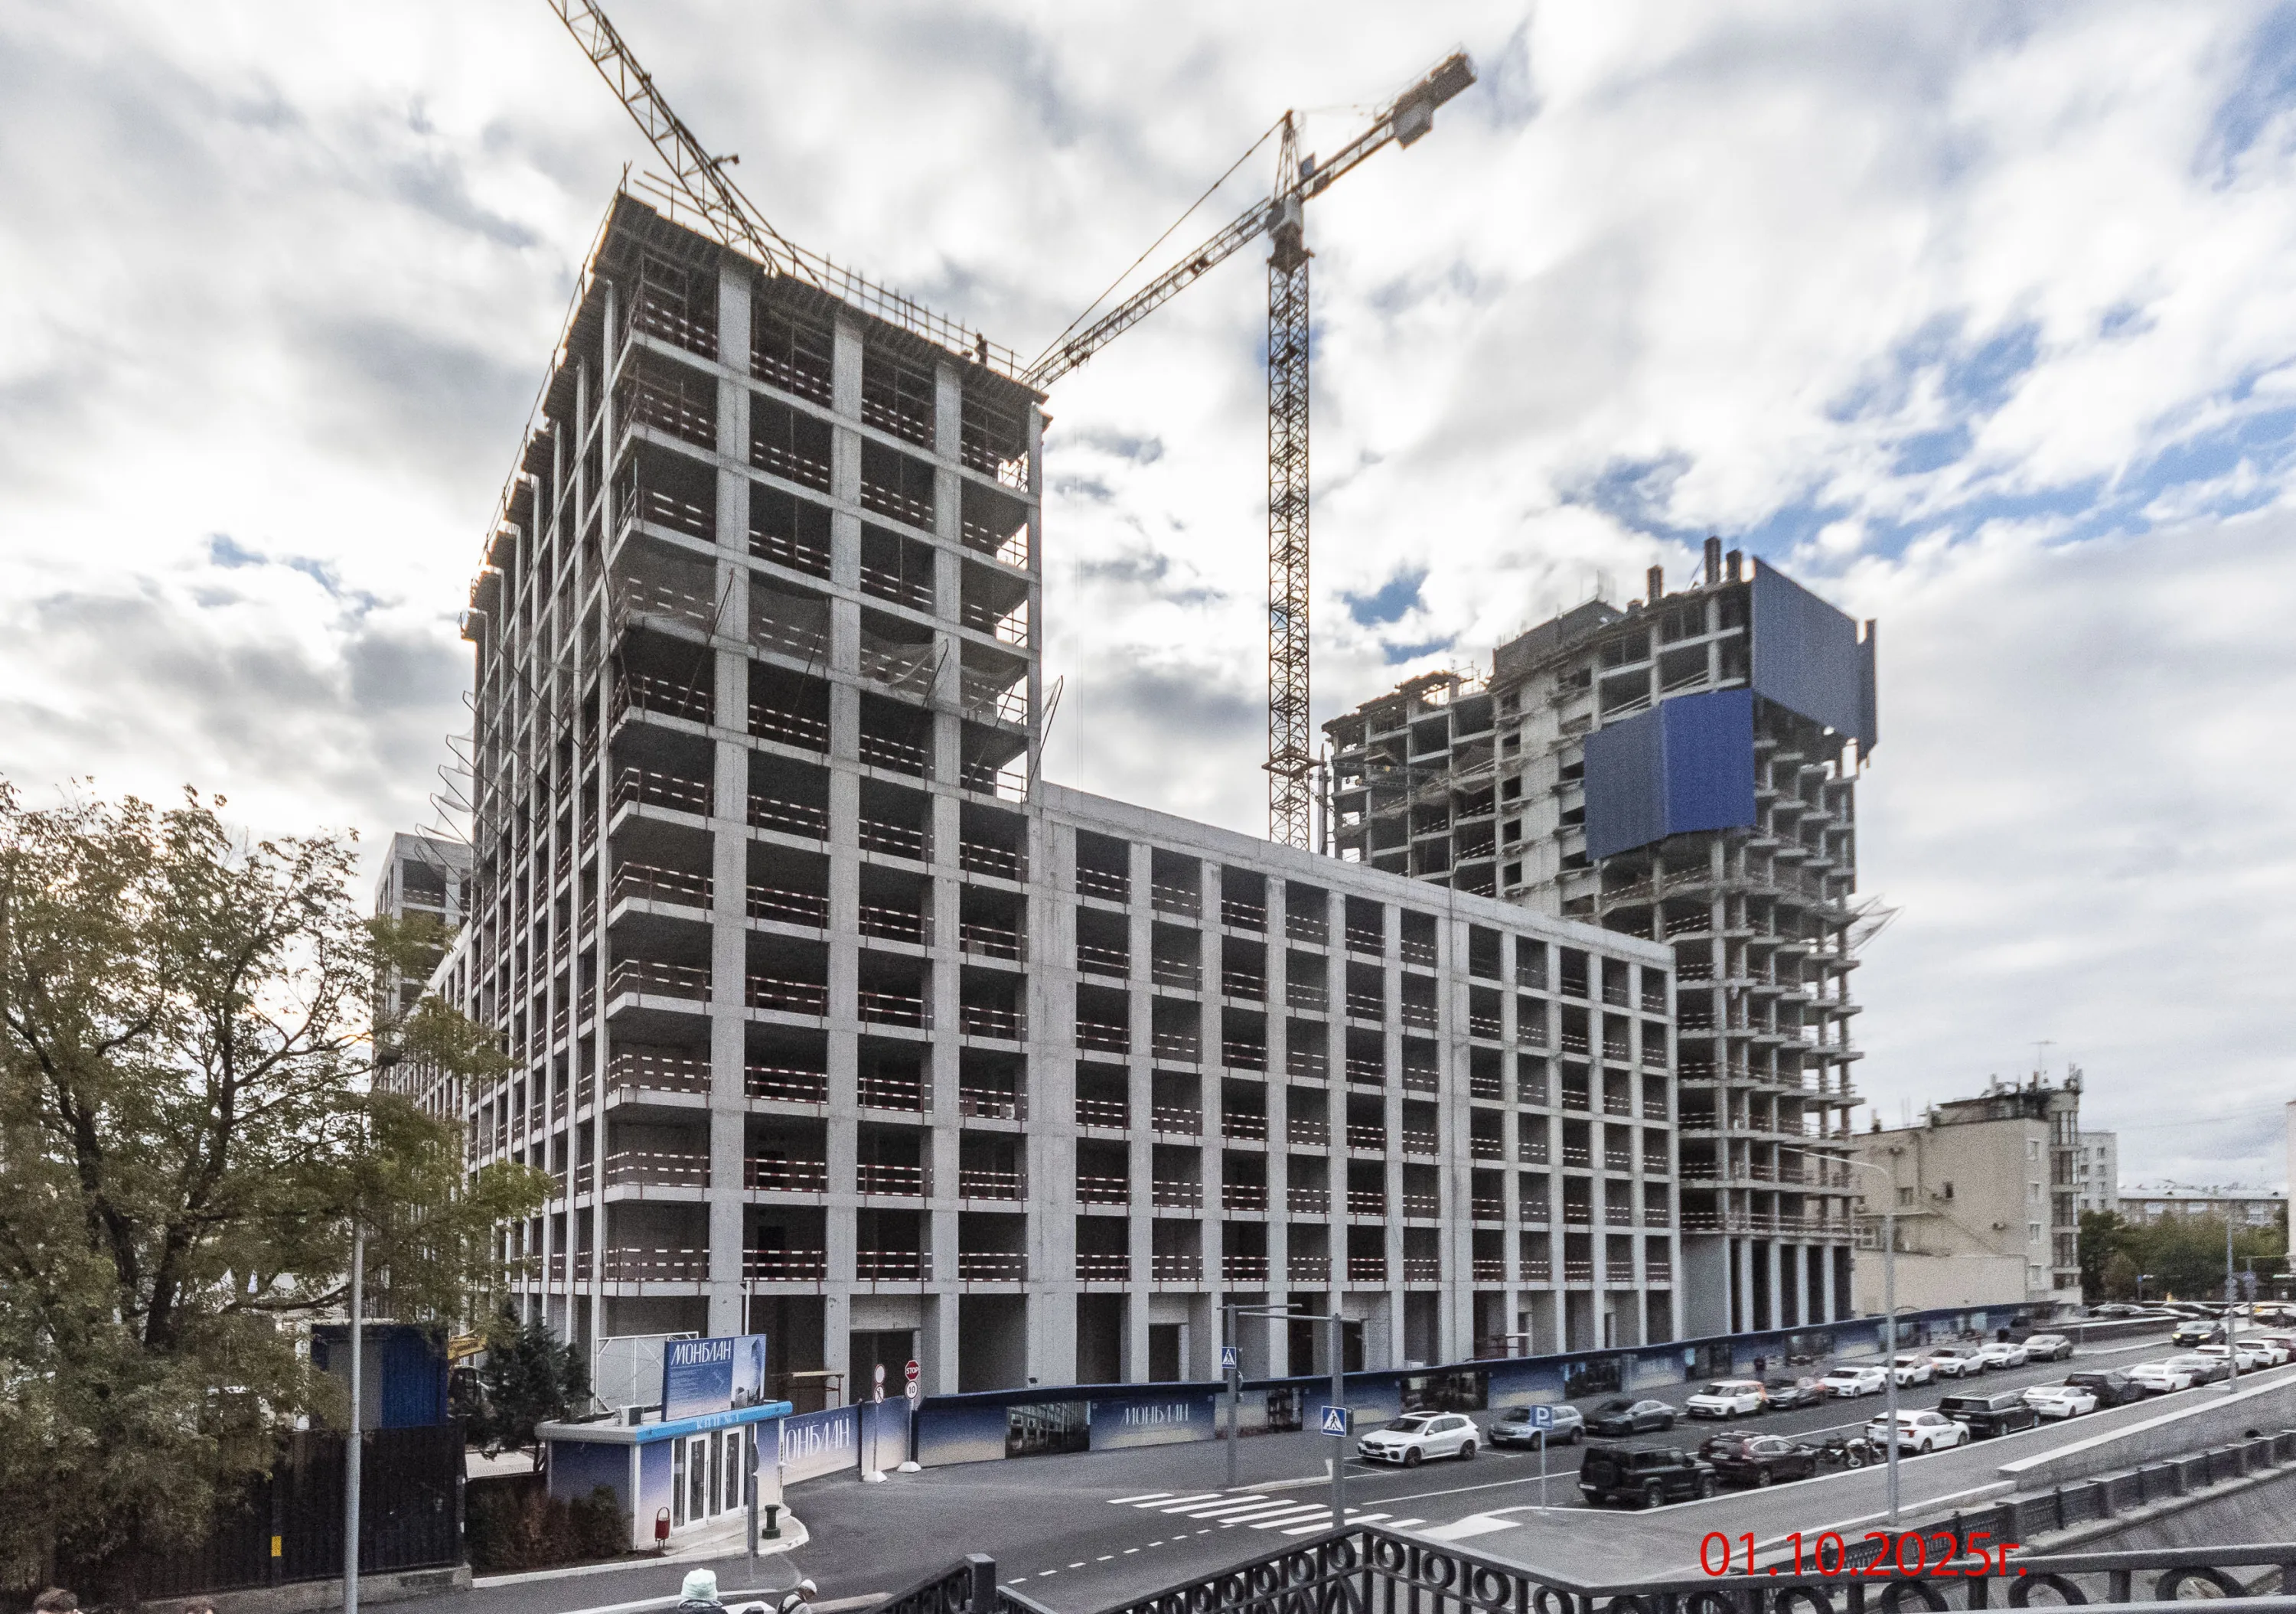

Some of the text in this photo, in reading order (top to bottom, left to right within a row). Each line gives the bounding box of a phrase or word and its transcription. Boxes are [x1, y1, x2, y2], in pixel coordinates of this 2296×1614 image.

[670, 1340, 732, 1366] МОНБЛАН
[906, 1366, 919, 1374] STOP
[908, 1386, 916, 1394] 10
[1120, 1403, 1189, 1427] МОНБЛАН
[1537, 1407, 1550, 1426] P
[785, 1417, 850, 1462] ОНБЛАН
